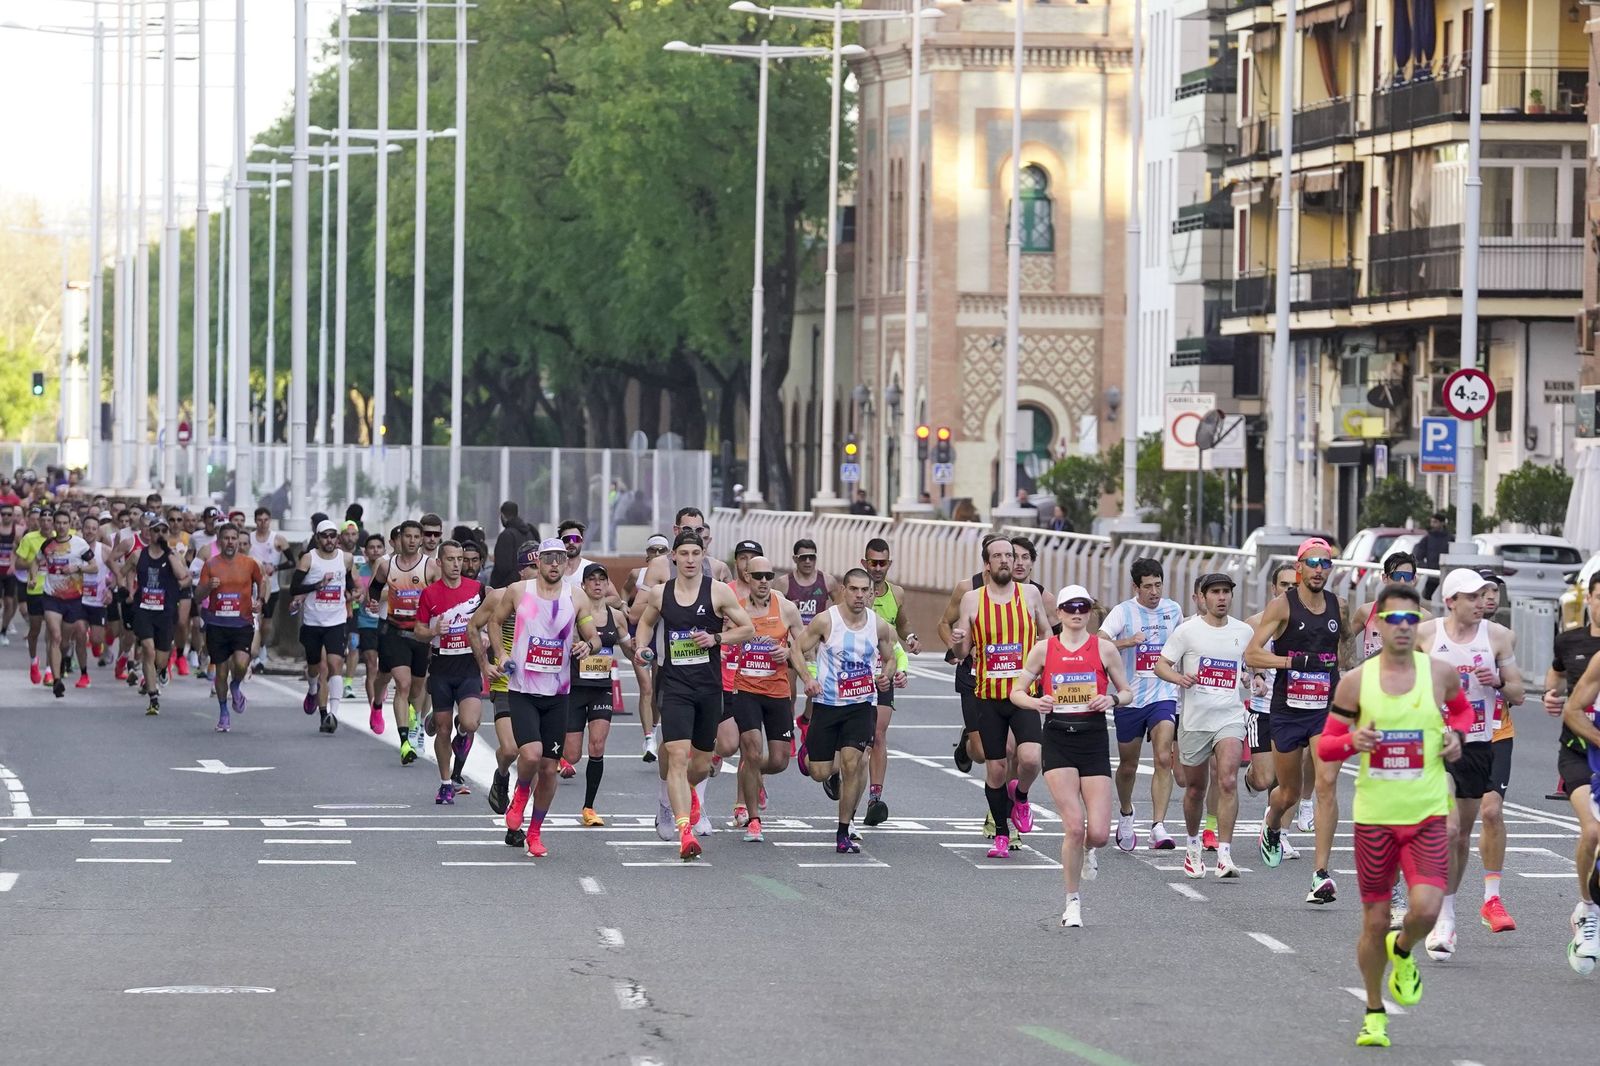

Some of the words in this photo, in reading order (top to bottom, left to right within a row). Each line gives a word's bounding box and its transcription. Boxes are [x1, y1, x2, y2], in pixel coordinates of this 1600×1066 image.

[1426, 422, 1448, 451] P
[447, 641, 465, 649] PORTI
[674, 649, 705, 657] MATHIEU
[531, 655, 559, 665] TANGUY
[746, 660, 770, 669] ERWAN
[992, 661, 1016, 671] JAMES
[850, 669, 869, 677] ZURICH
[1200, 676, 1215, 685] TOM
[1217, 678, 1233, 687] TOM
[843, 685, 872, 697] ANTONIO
[1058, 695, 1091, 704] PAULINE
[1383, 757, 1409, 768] RUBI
